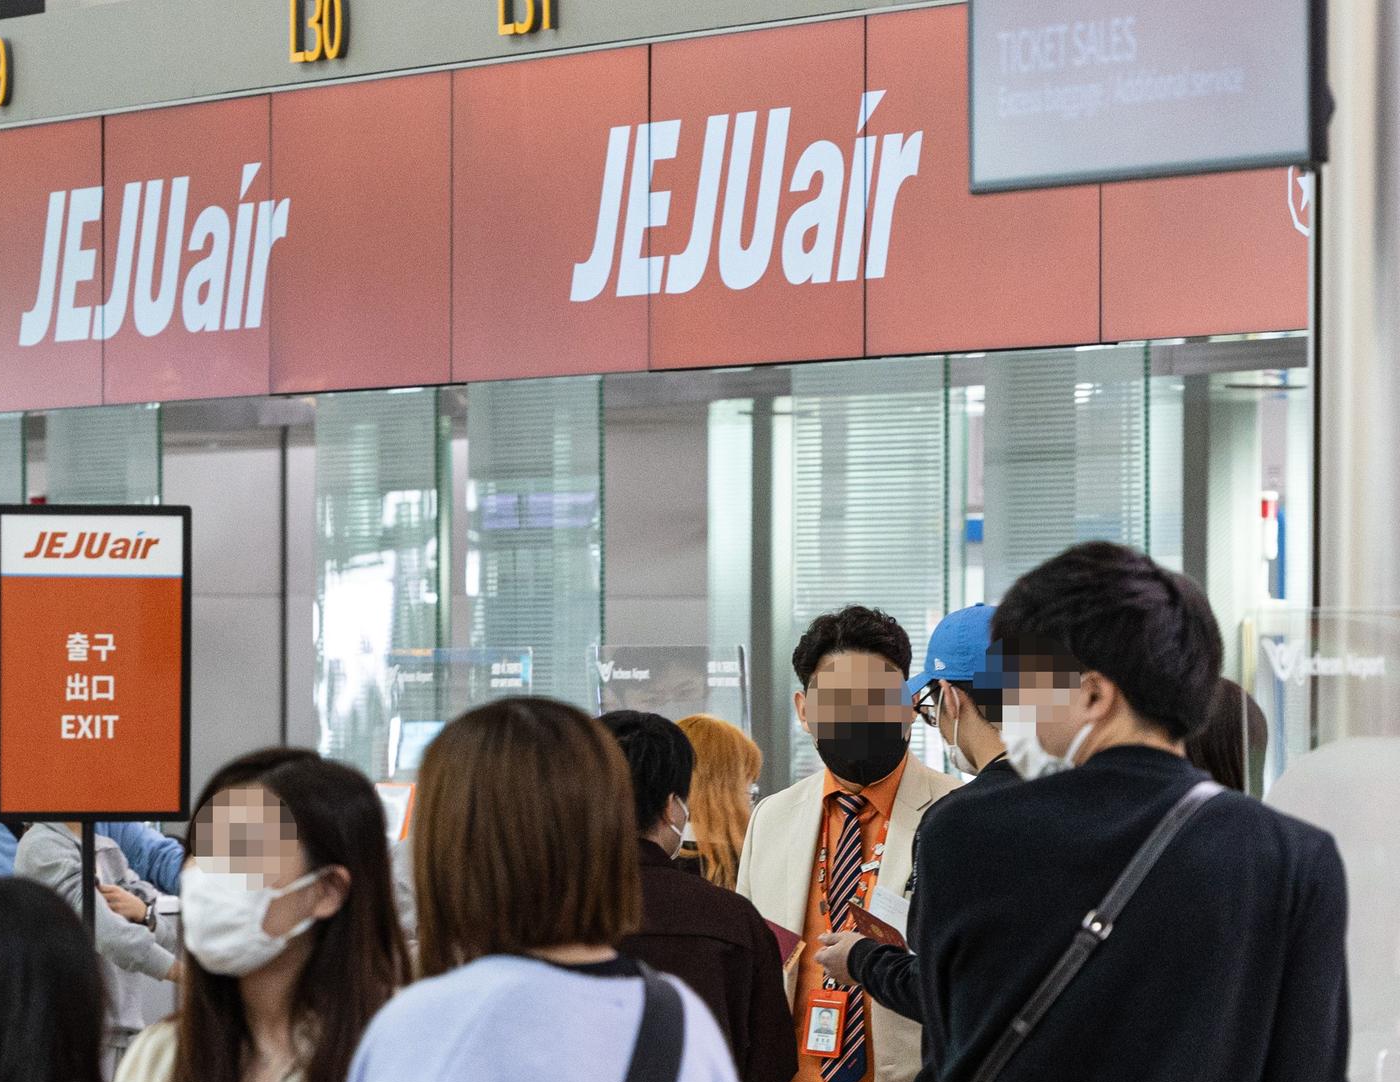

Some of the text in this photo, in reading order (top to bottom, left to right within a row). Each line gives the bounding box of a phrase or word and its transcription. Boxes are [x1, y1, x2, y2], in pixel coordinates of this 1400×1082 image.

[290, 0, 342, 62] L30
[997, 16, 1138, 74] TICKET SALES
[65, 632, 116, 662] 출구
[65, 673, 115, 701] 出口
[61, 714, 120, 739] EXIT
